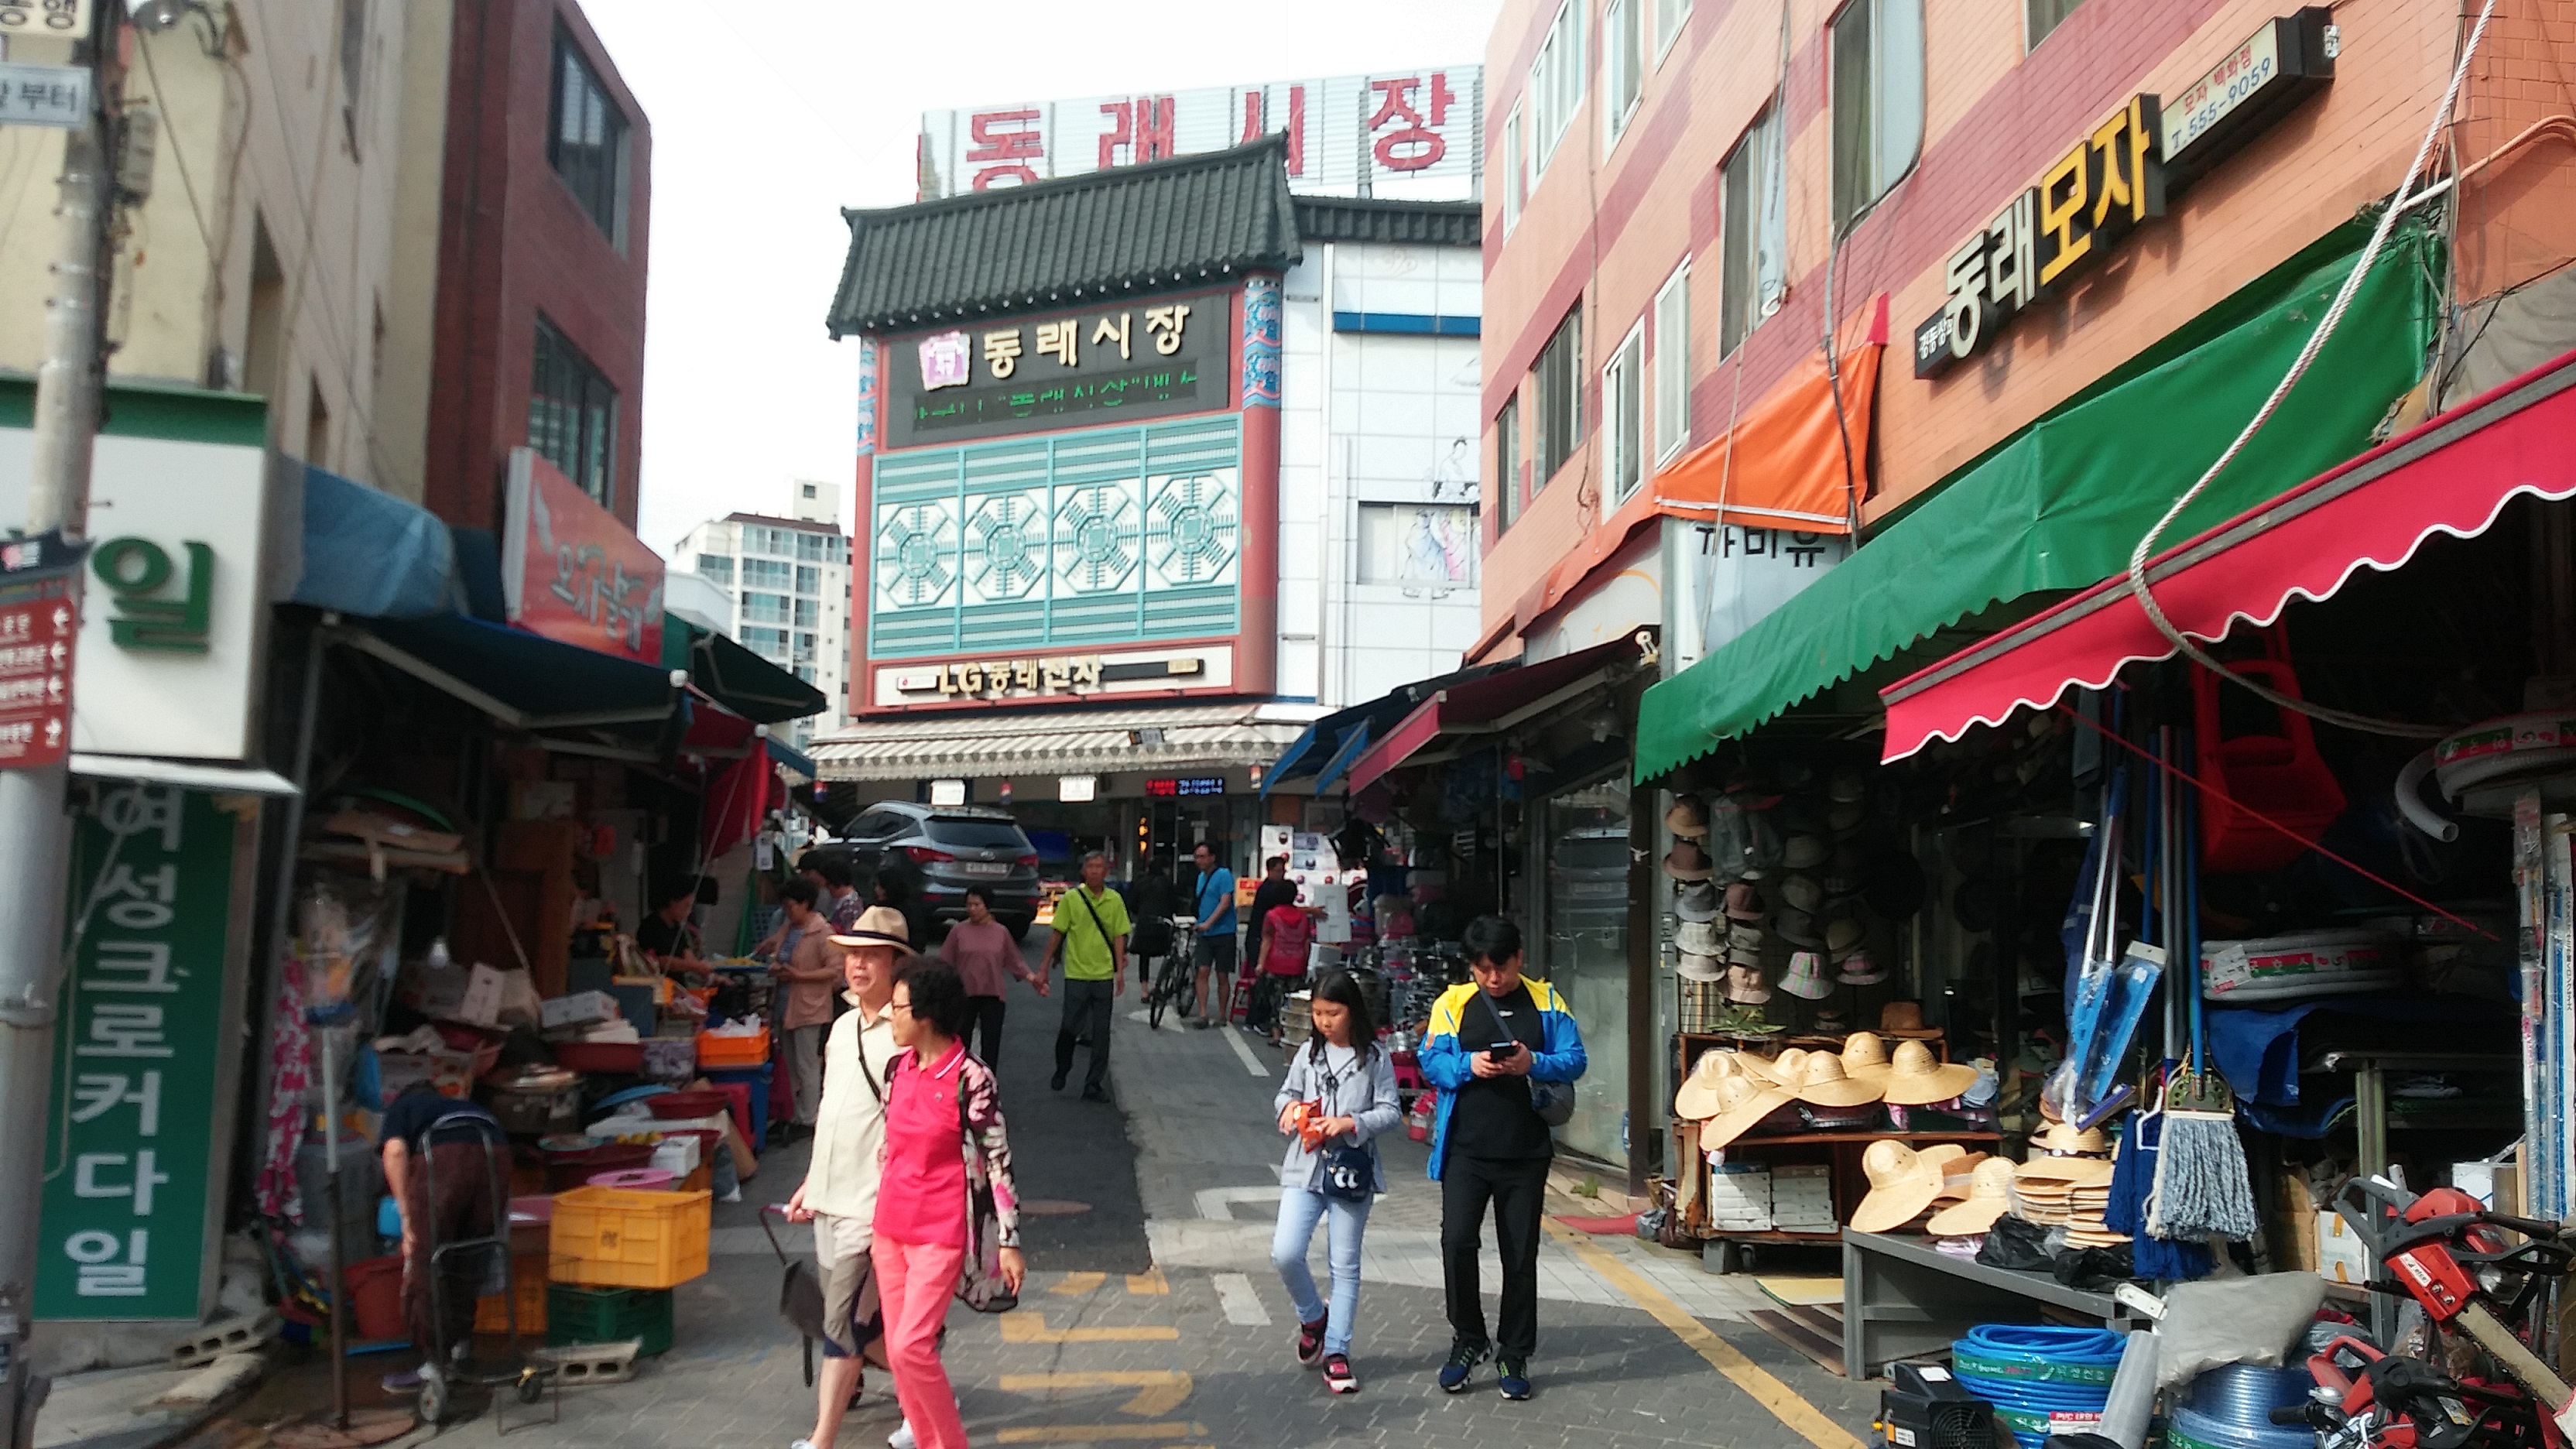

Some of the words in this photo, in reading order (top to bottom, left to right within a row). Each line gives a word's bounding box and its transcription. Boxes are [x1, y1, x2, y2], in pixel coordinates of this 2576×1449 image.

[2184, 85, 2208, 116] 모자
[2213, 44, 2252, 87] 백화점
[967, 73, 1455, 192] 동래시장
[984, 304, 1190, 379] 동래시장
